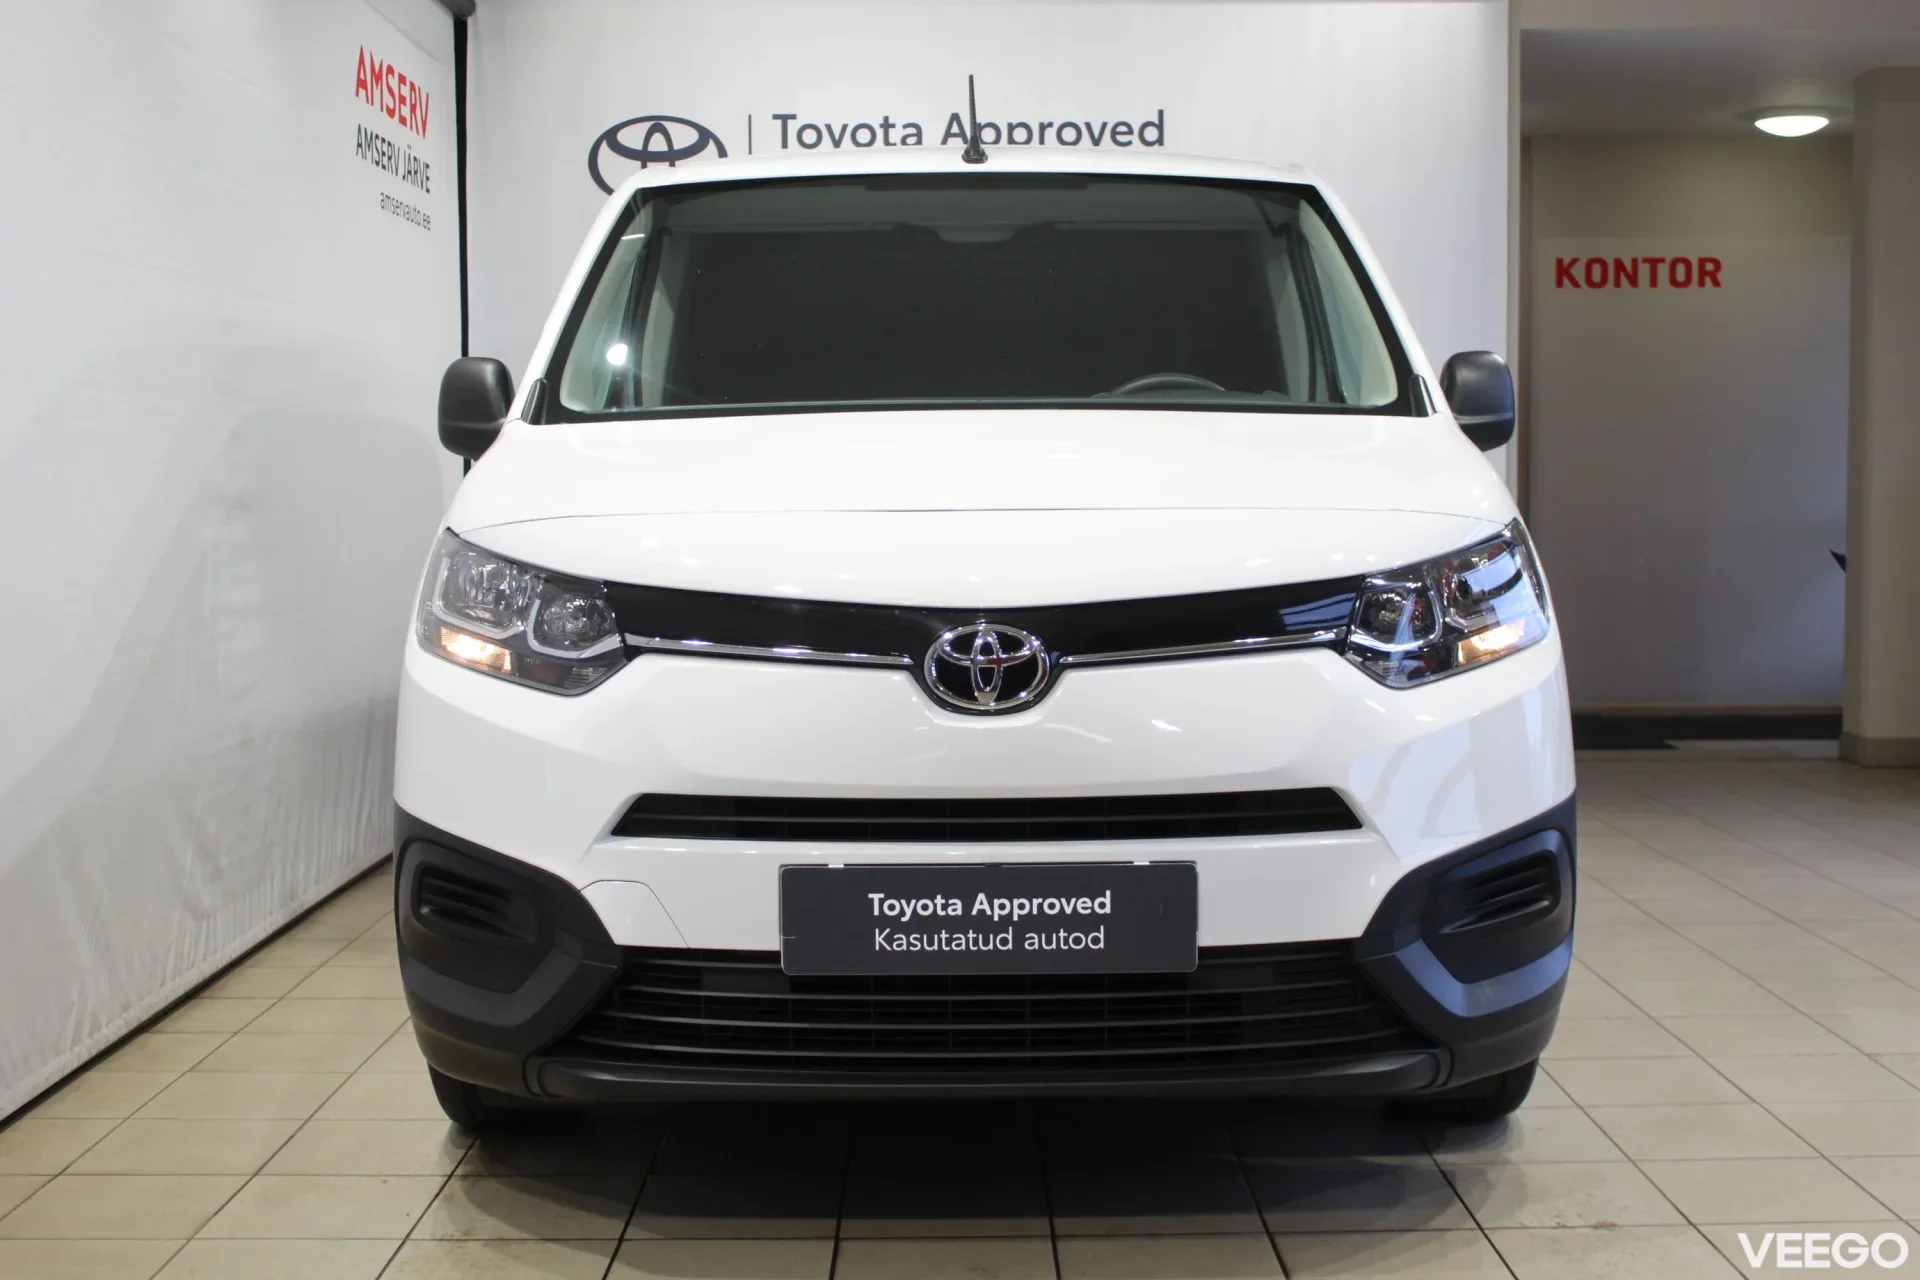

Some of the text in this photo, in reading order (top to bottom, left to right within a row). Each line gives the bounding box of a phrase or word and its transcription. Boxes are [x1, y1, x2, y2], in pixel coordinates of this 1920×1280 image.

[355, 44, 429, 140] AMSERV
[356, 123, 430, 194] AMSERV JÄRVE
[380, 192, 431, 231] amservauto.ee
[1555, 256, 1722, 289] KONTOR
[868, 890, 1111, 921] Toyota Approved
[875, 925, 1104, 951] Kasutatud autod
